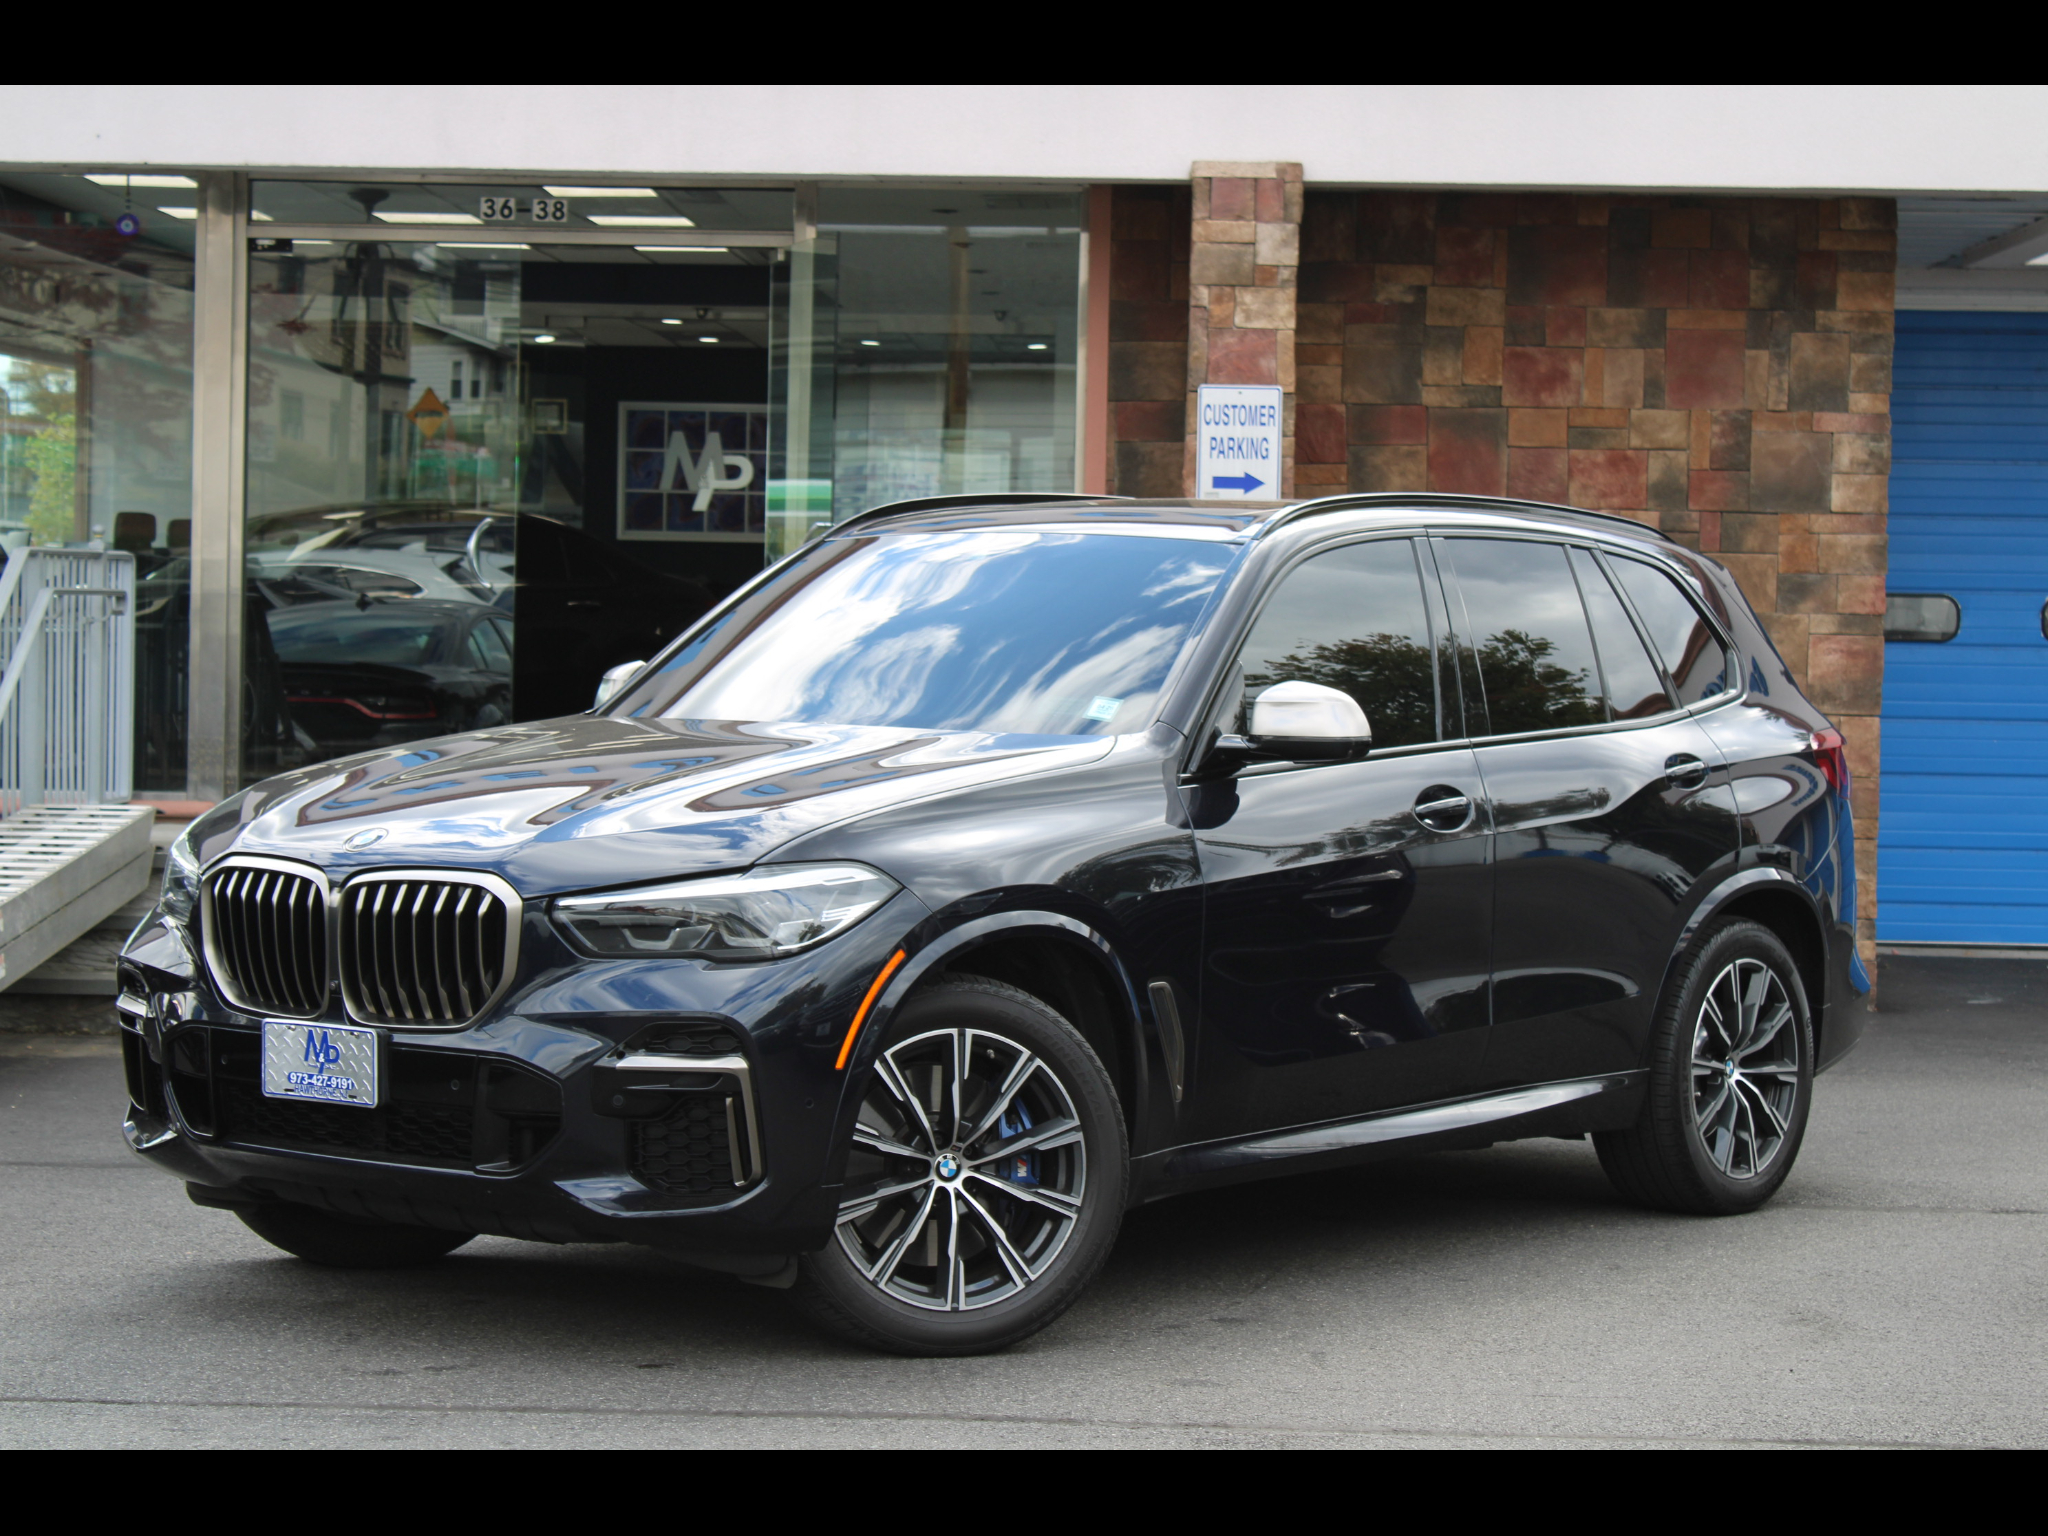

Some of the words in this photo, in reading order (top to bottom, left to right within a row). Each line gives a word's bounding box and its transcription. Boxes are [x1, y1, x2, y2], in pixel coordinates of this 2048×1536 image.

[483, 198, 565, 221] 36-38
[1203, 404, 1277, 427] CUSTOMER
[1209, 436, 1269, 460] PARKING
[290, 1072, 353, 1090] 973-427-9191
